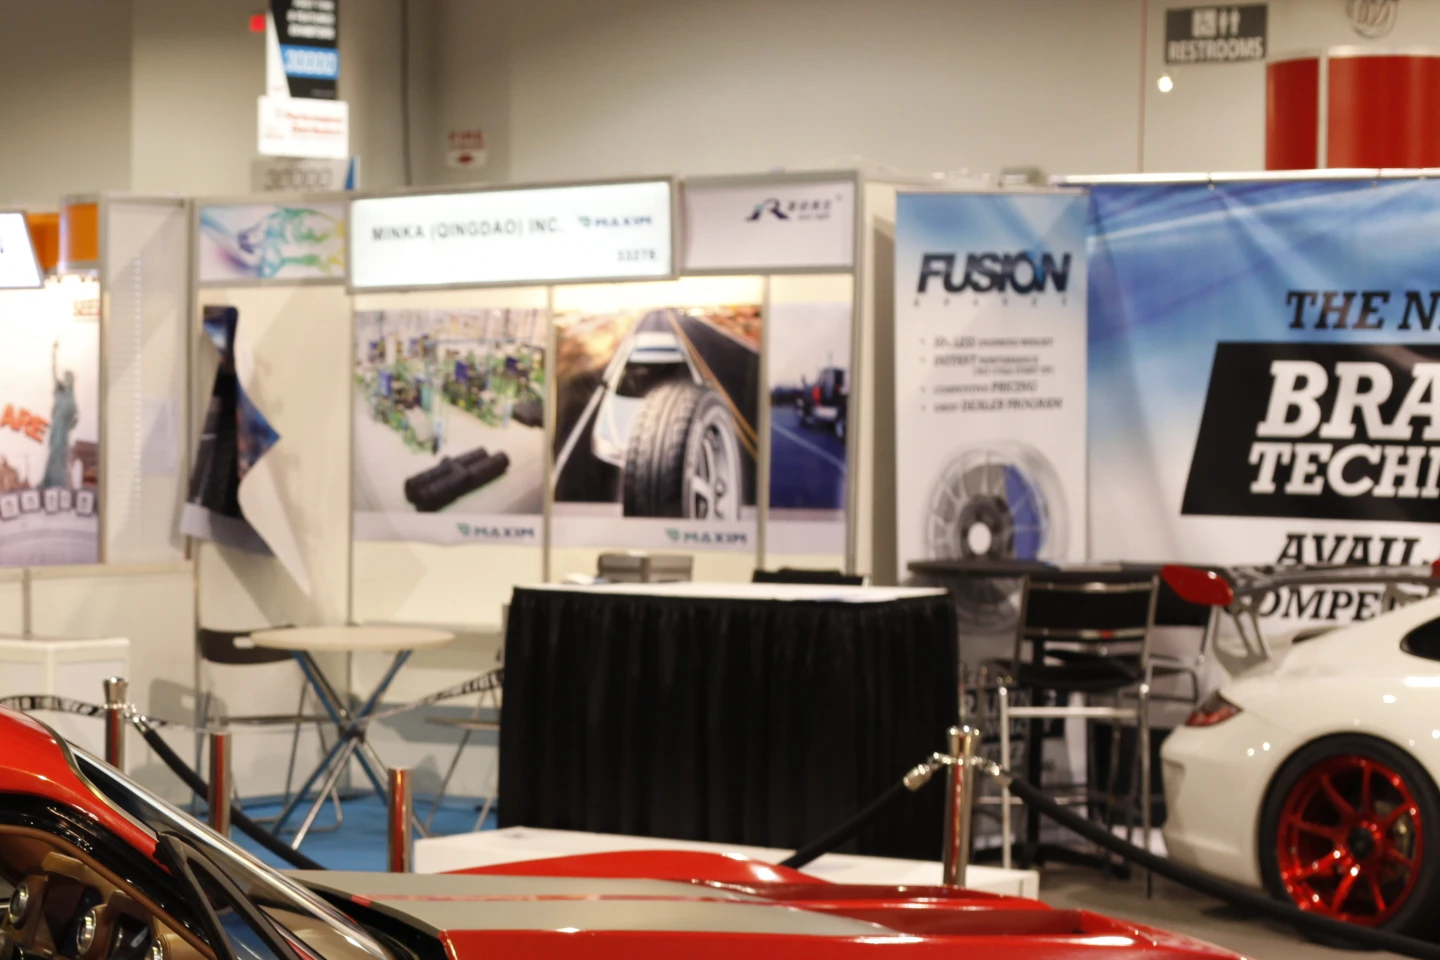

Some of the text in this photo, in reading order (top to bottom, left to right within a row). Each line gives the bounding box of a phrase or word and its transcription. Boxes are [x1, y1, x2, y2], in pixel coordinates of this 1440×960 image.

[1167, 37, 1264, 61] RESTROOMS
[371, 223, 424, 242] MINKA
[429, 217, 523, 243] (QINGDAO)
[917, 251, 1073, 295] FUSION
[1286, 289, 1391, 330] THE
[1256, 360, 1440, 441] BRA
[0, 403, 49, 444] ARE
[1259, 586, 1400, 622] OMPE
